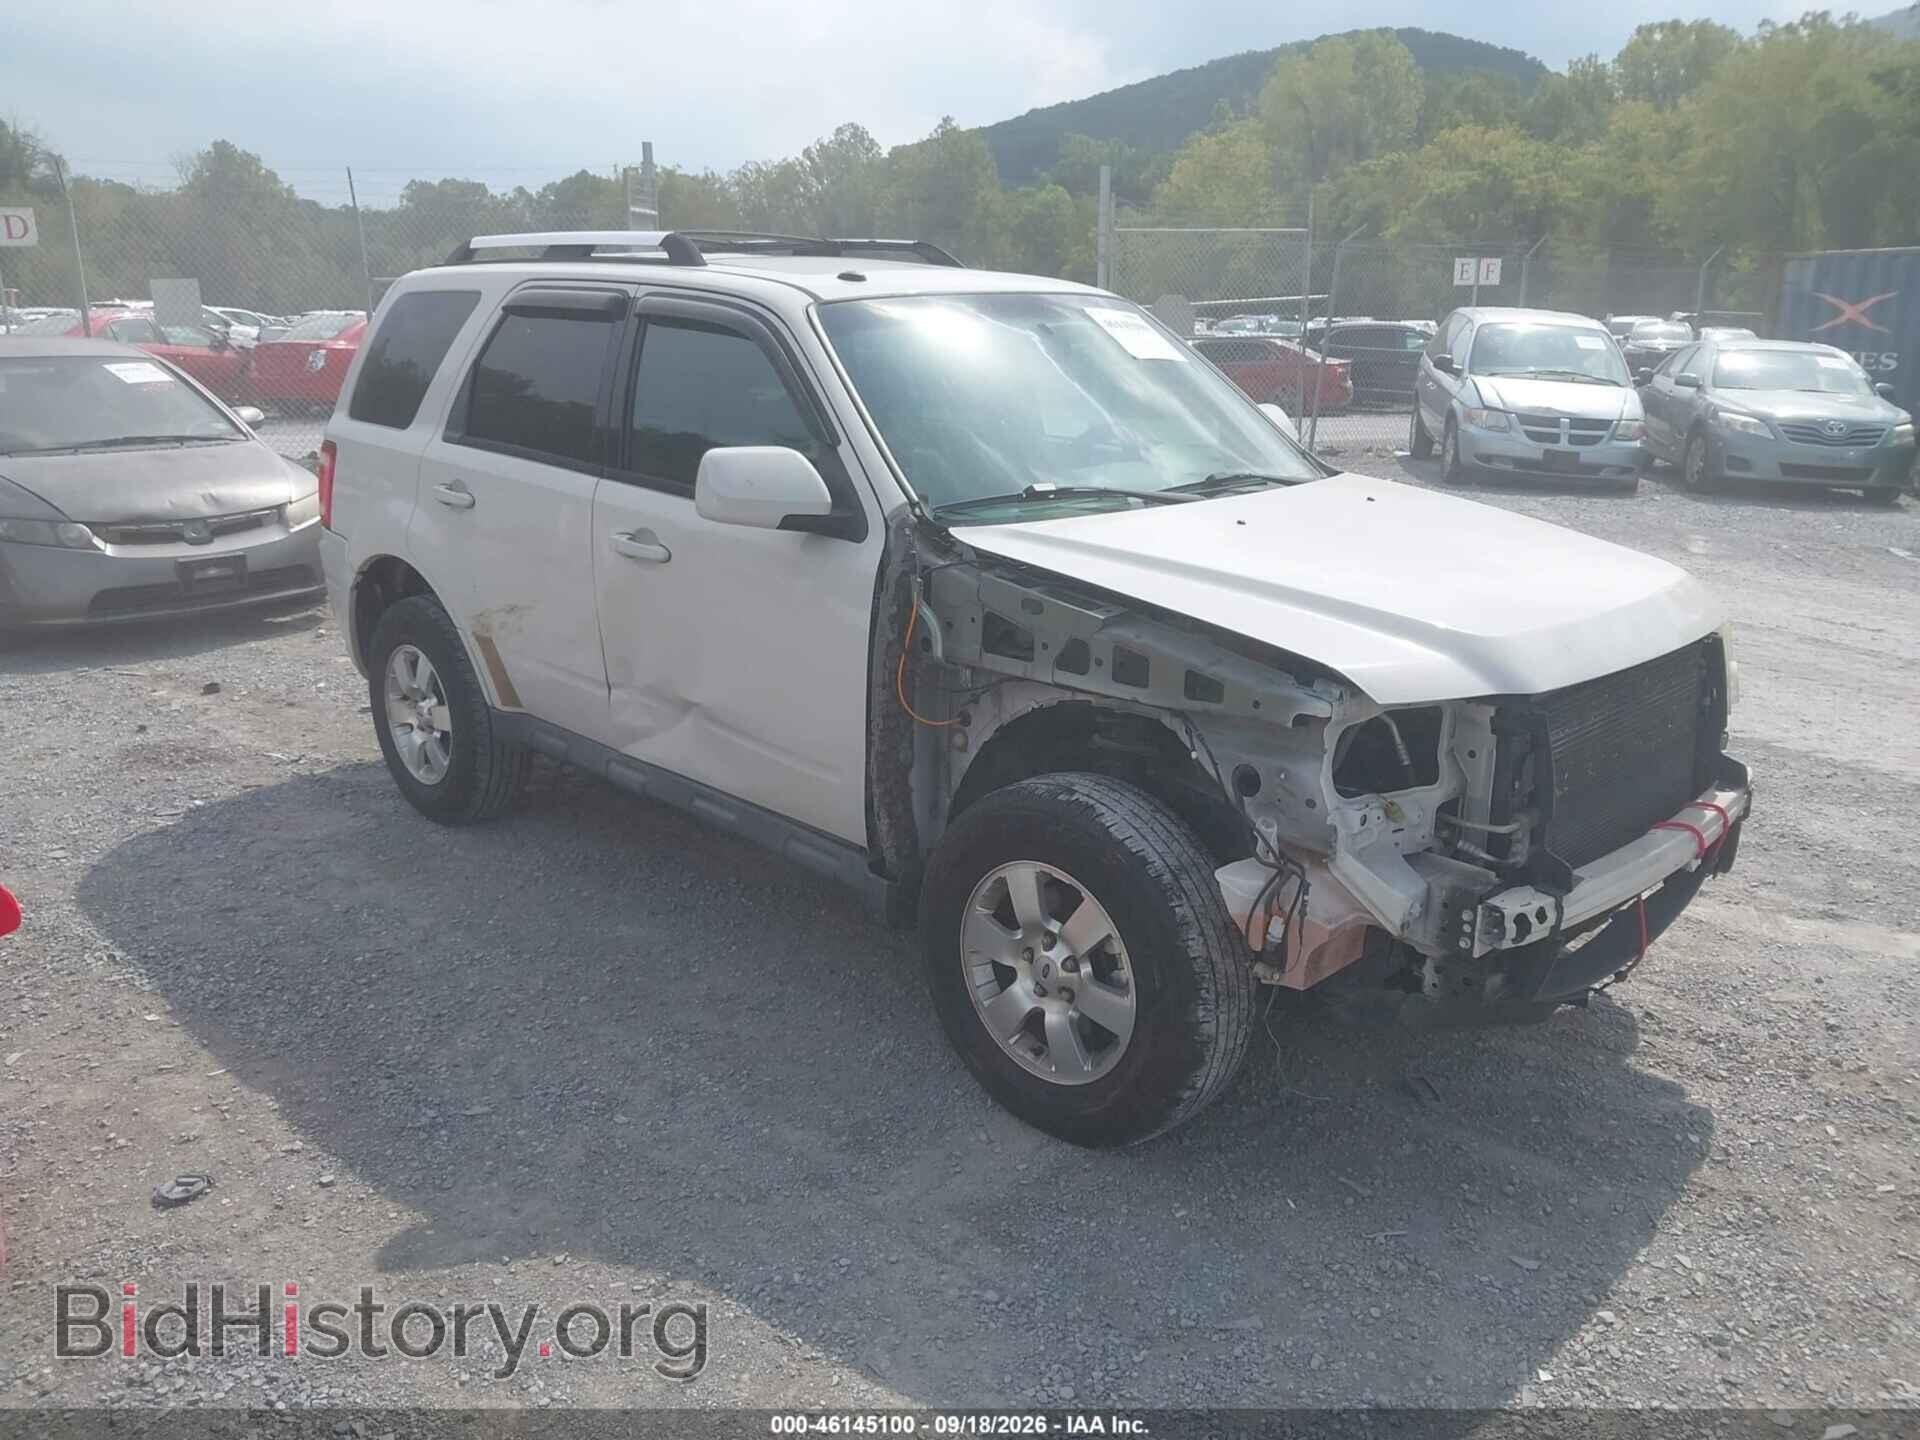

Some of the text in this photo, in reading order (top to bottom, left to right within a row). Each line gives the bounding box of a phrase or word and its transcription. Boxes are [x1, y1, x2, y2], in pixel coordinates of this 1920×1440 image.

[2, 214, 29, 240] D
[1459, 262, 1472, 281] E
[1849, 351, 1899, 370] ES
